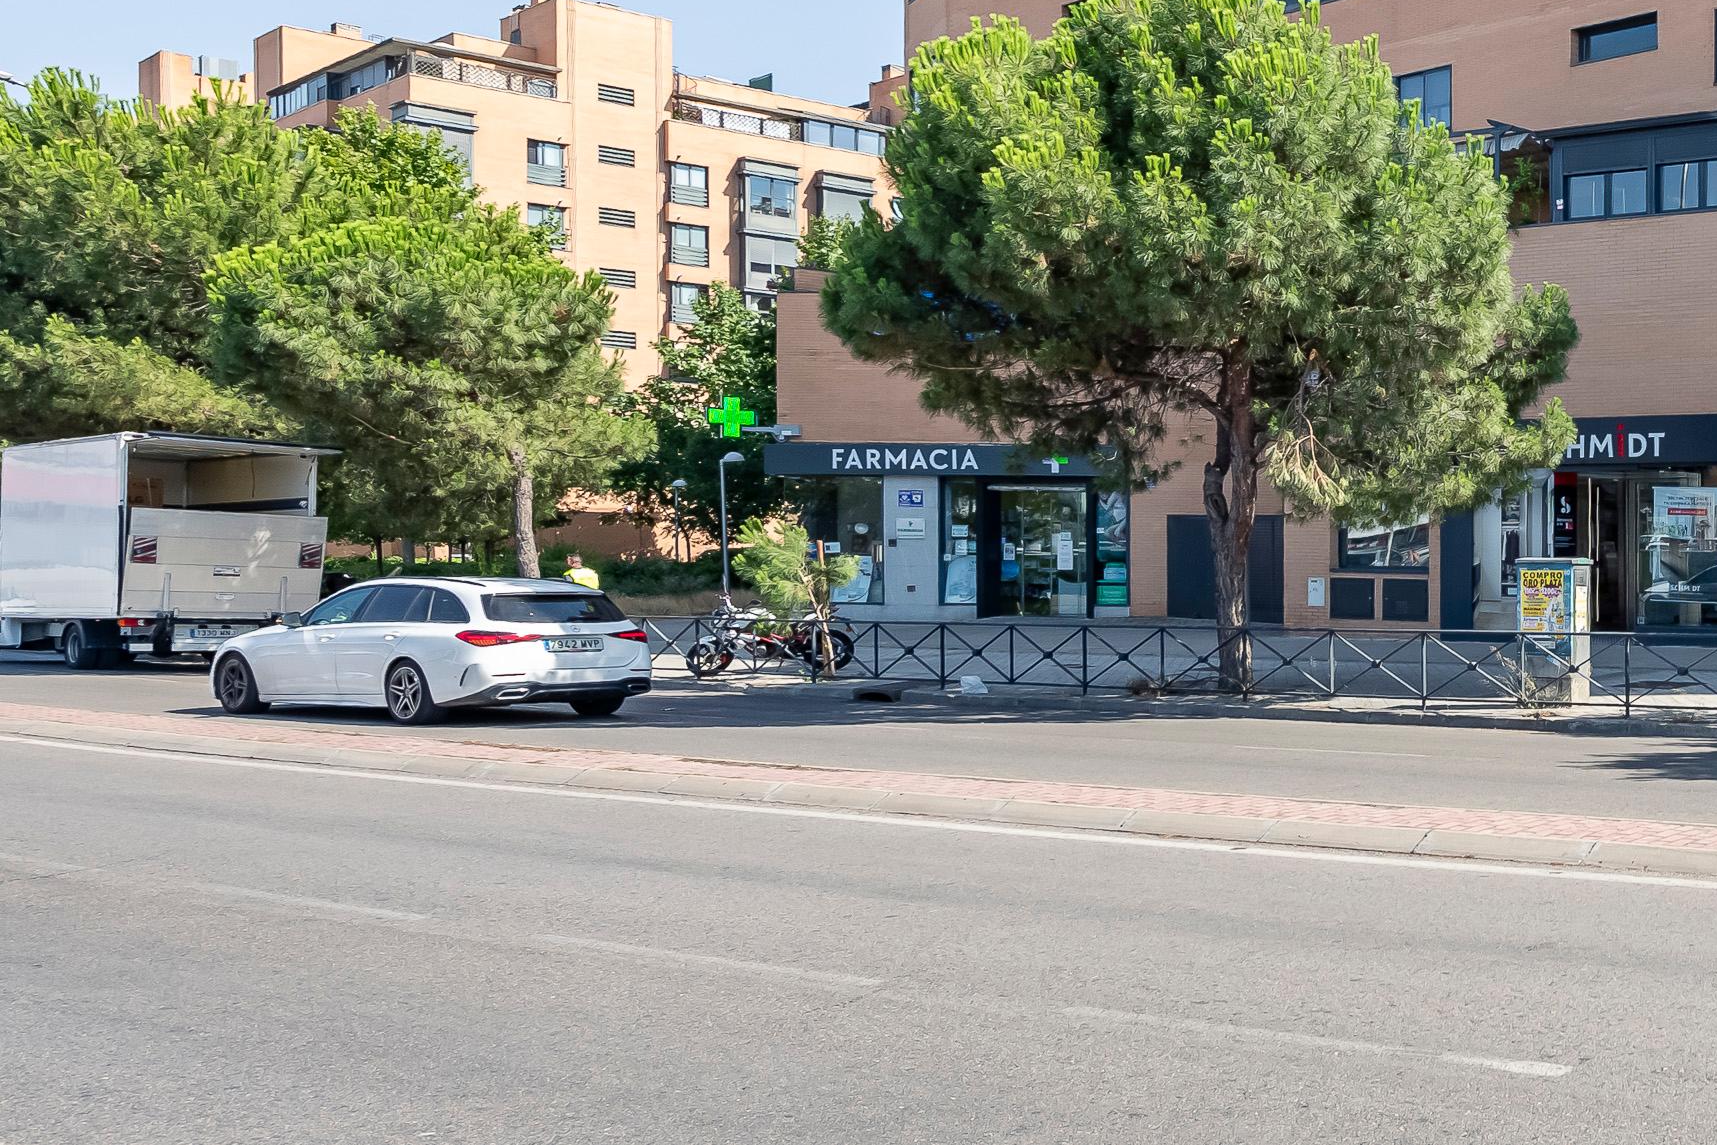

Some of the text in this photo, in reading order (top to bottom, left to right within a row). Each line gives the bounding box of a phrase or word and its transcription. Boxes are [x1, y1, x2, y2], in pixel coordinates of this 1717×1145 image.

[831, 448, 980, 470] FARMACIA
[1522, 571, 1563, 579] COMPRO
[1522, 579, 1563, 587] ORO PLATA
[551, 639, 600, 649] 7942 MVP
